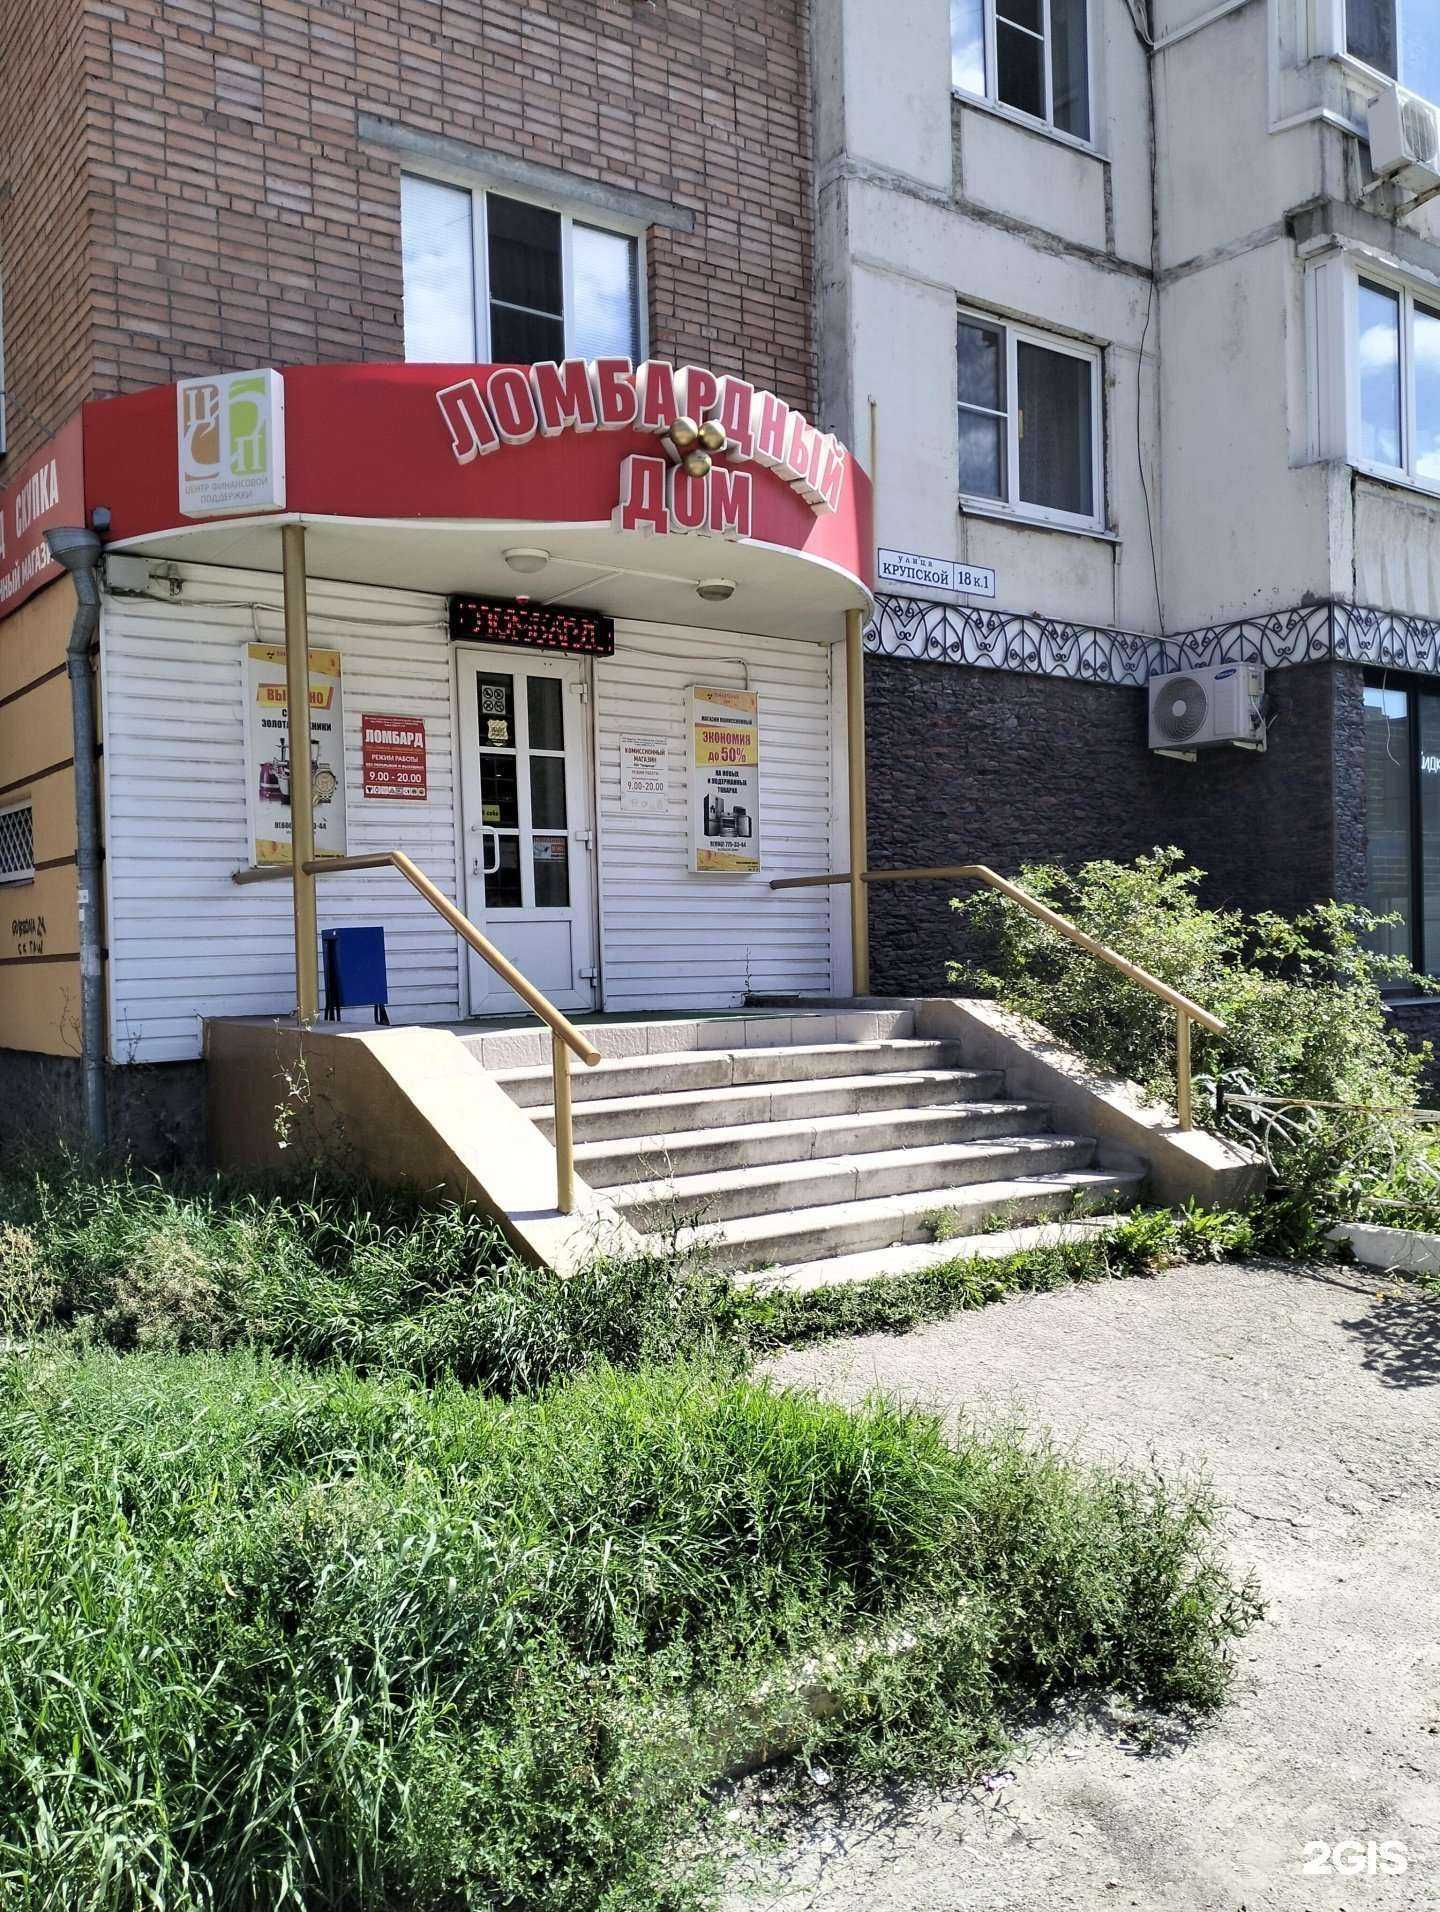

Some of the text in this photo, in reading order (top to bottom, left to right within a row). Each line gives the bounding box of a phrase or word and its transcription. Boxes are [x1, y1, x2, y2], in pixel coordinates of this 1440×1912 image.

[435, 357, 848, 514] ЛОМБАРДНЫЙ
[15, 458, 59, 538] СКУПКА
[612, 453, 753, 536] ДОМ
[22, 541, 53, 585] МАГАЗИ
[883, 562, 949, 585] КРУПСКОЙ
[958, 571, 972, 586] 18
[267, 688, 324, 704] ВЫНО
[365, 729, 424, 748] ЛОМБАРД
[702, 731, 751, 746] ЭКОНОМИЯ
[624, 747, 666, 755] КОМИССИОННЫЙ
[633, 755, 657, 763] МАГАЗИН
[721, 747, 747, 762] 50%
[397, 772, 422, 783] 20.00
